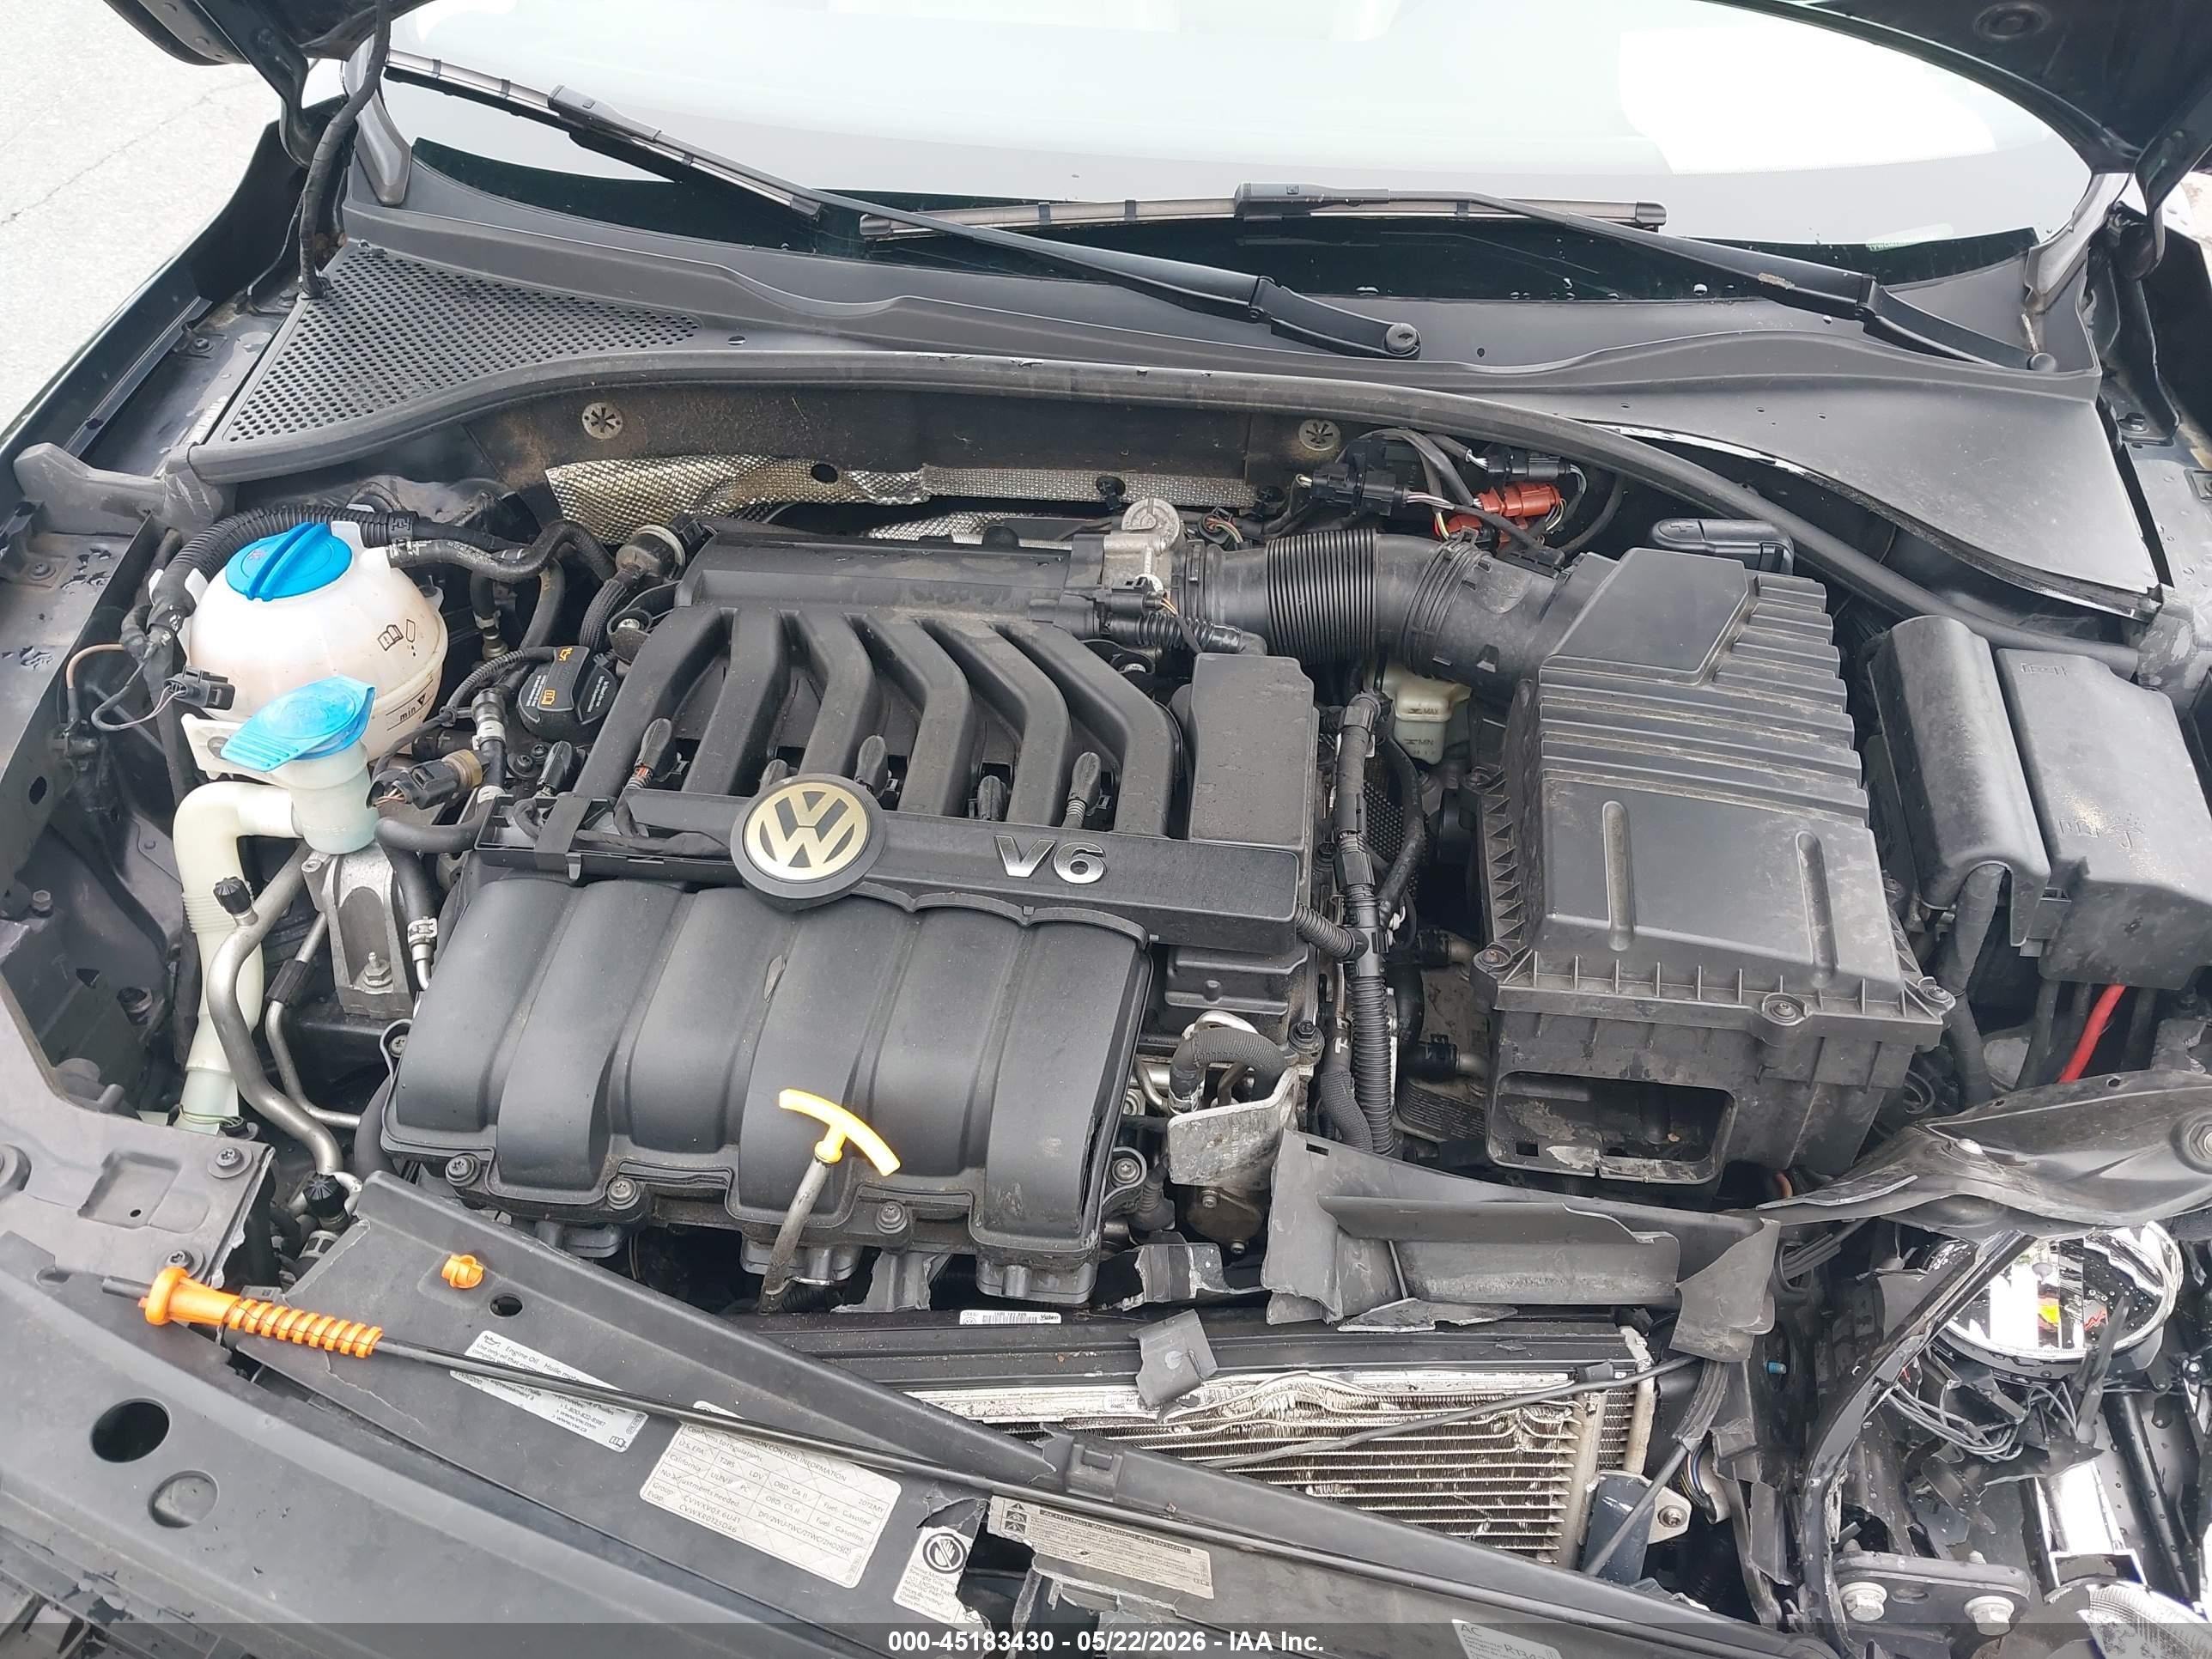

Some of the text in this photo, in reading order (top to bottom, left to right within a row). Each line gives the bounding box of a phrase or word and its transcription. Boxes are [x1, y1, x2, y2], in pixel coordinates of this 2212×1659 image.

[400, 707, 416, 721] min
[994, 835, 1107, 884] V6
[505, 1345, 538, 1364] Engine Oil
[686, 1425, 719, 1443] Conforms
[725, 1442, 763, 1463] regulations
[768, 1443, 799, 1462] CONTROL
[799, 1456, 846, 1482] INFORMATION
[660, 1468, 672, 1477] No
[669, 1472, 714, 1497] adjustments
[748, 1469, 763, 1480] LDV
[842, 1509, 872, 1527] Gasoline
[834, 1524, 865, 1542] Gasoline
[1462, 1625, 1481, 1636] AC
